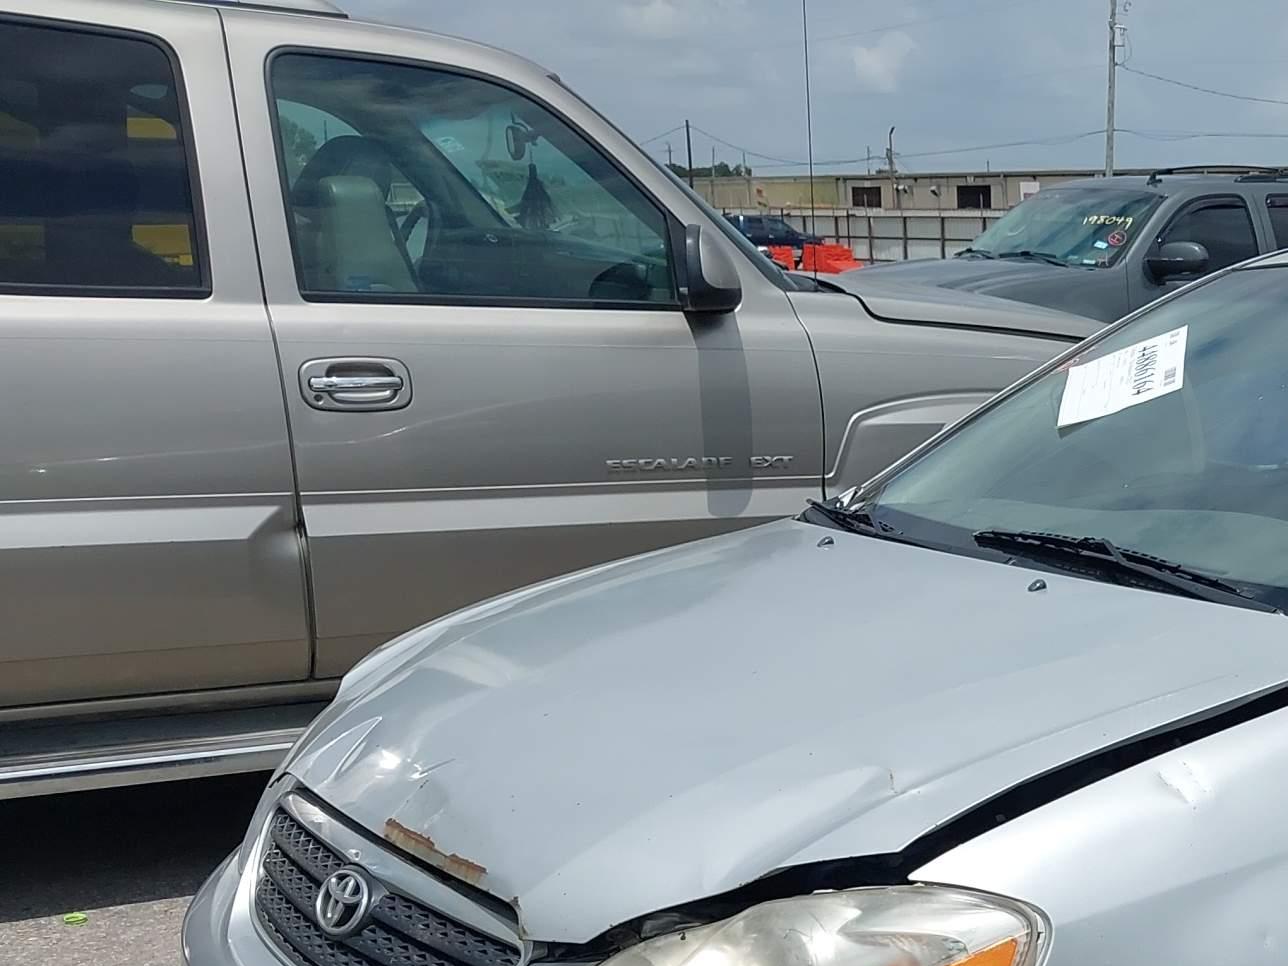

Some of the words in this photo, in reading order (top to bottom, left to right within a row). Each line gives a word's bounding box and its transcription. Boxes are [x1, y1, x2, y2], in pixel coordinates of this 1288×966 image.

[1082, 215, 1133, 231] 198049
[1131, 343, 1159, 397] 44886164
[606, 457, 734, 472] ESCALADE
[749, 455, 794, 469] EXT
